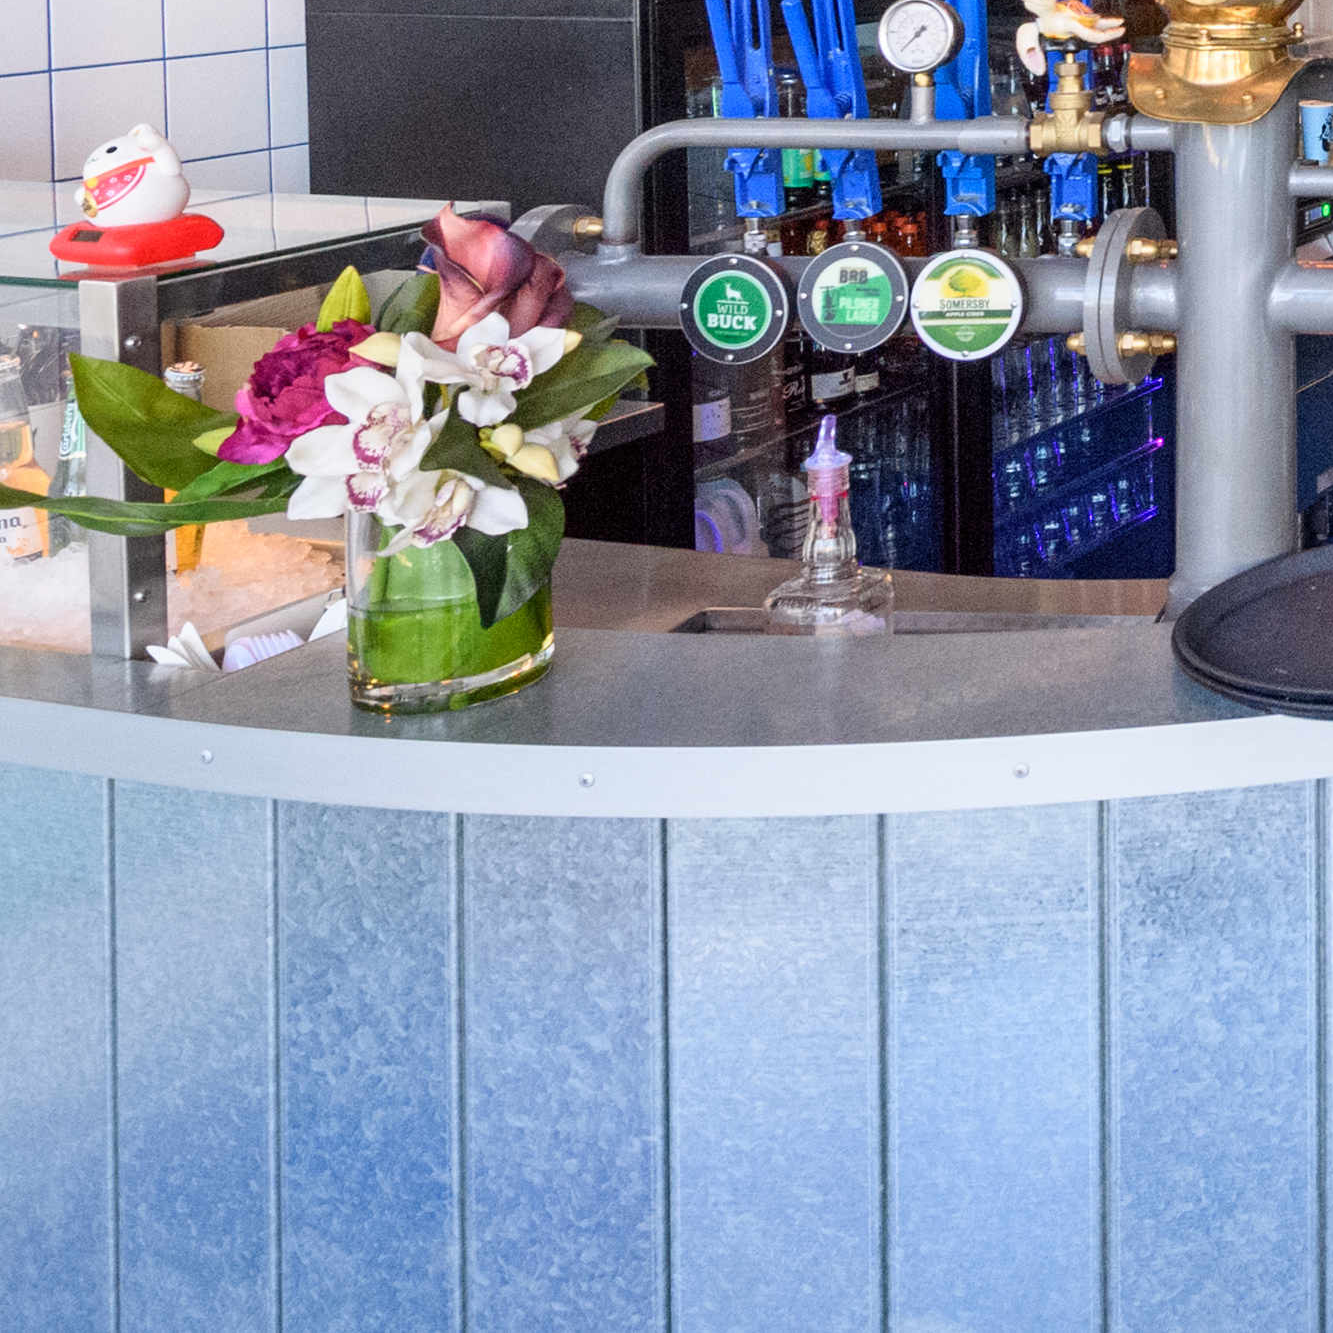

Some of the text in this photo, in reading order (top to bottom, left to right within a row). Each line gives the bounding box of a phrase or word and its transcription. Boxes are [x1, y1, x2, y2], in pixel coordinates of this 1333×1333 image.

[717, 303, 749, 315] WILD
[939, 297, 991, 309] SOMERSBY
[707, 313, 758, 330] BUCK
